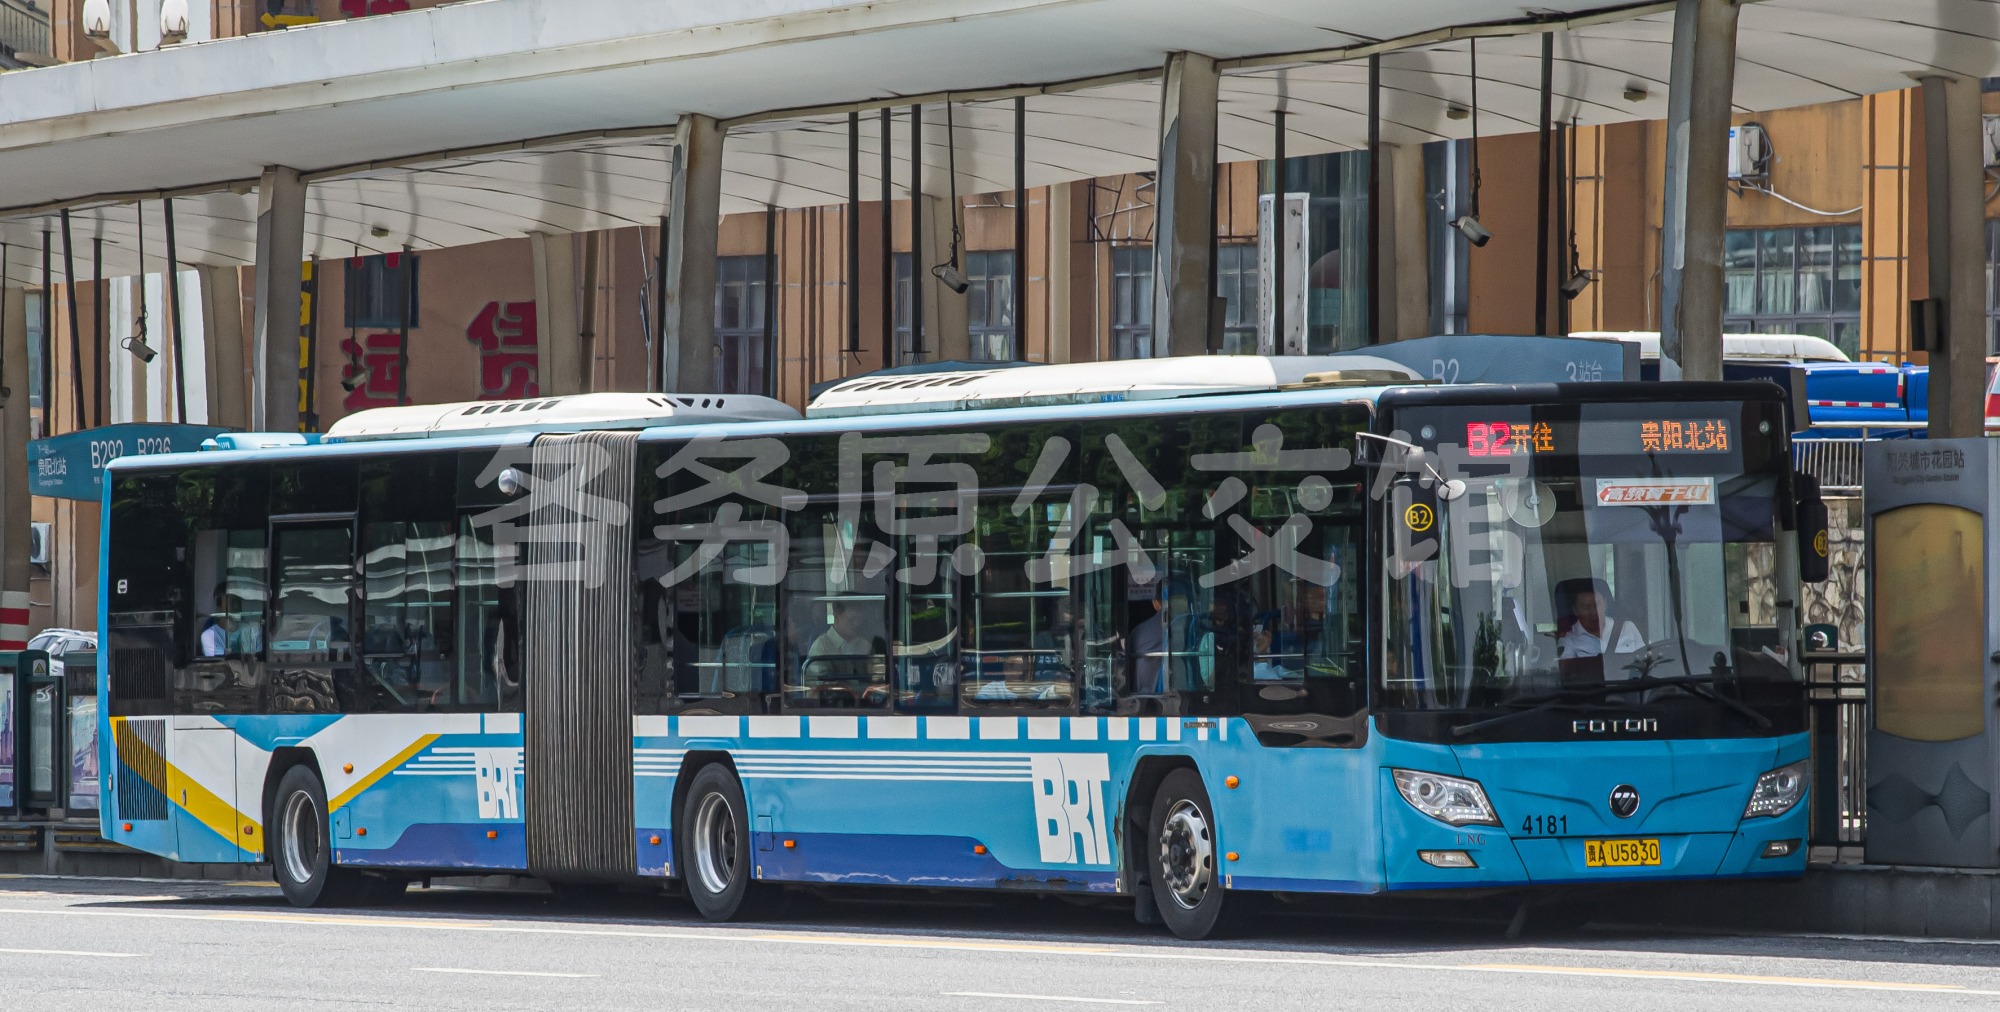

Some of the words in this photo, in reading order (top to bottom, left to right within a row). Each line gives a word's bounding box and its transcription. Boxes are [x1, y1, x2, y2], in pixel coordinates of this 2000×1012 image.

[1432, 359, 1460, 384] B2
[1640, 420, 1728, 452] 贵阳北站
[38, 456, 67, 477] 贵阳北站
[1410, 510, 1429, 525] B2
[475, 749, 519, 819] BRT
[1030, 753, 1111, 865] BRT
[1522, 815, 1568, 835] 4181
[1456, 834, 1487, 846] LNG
